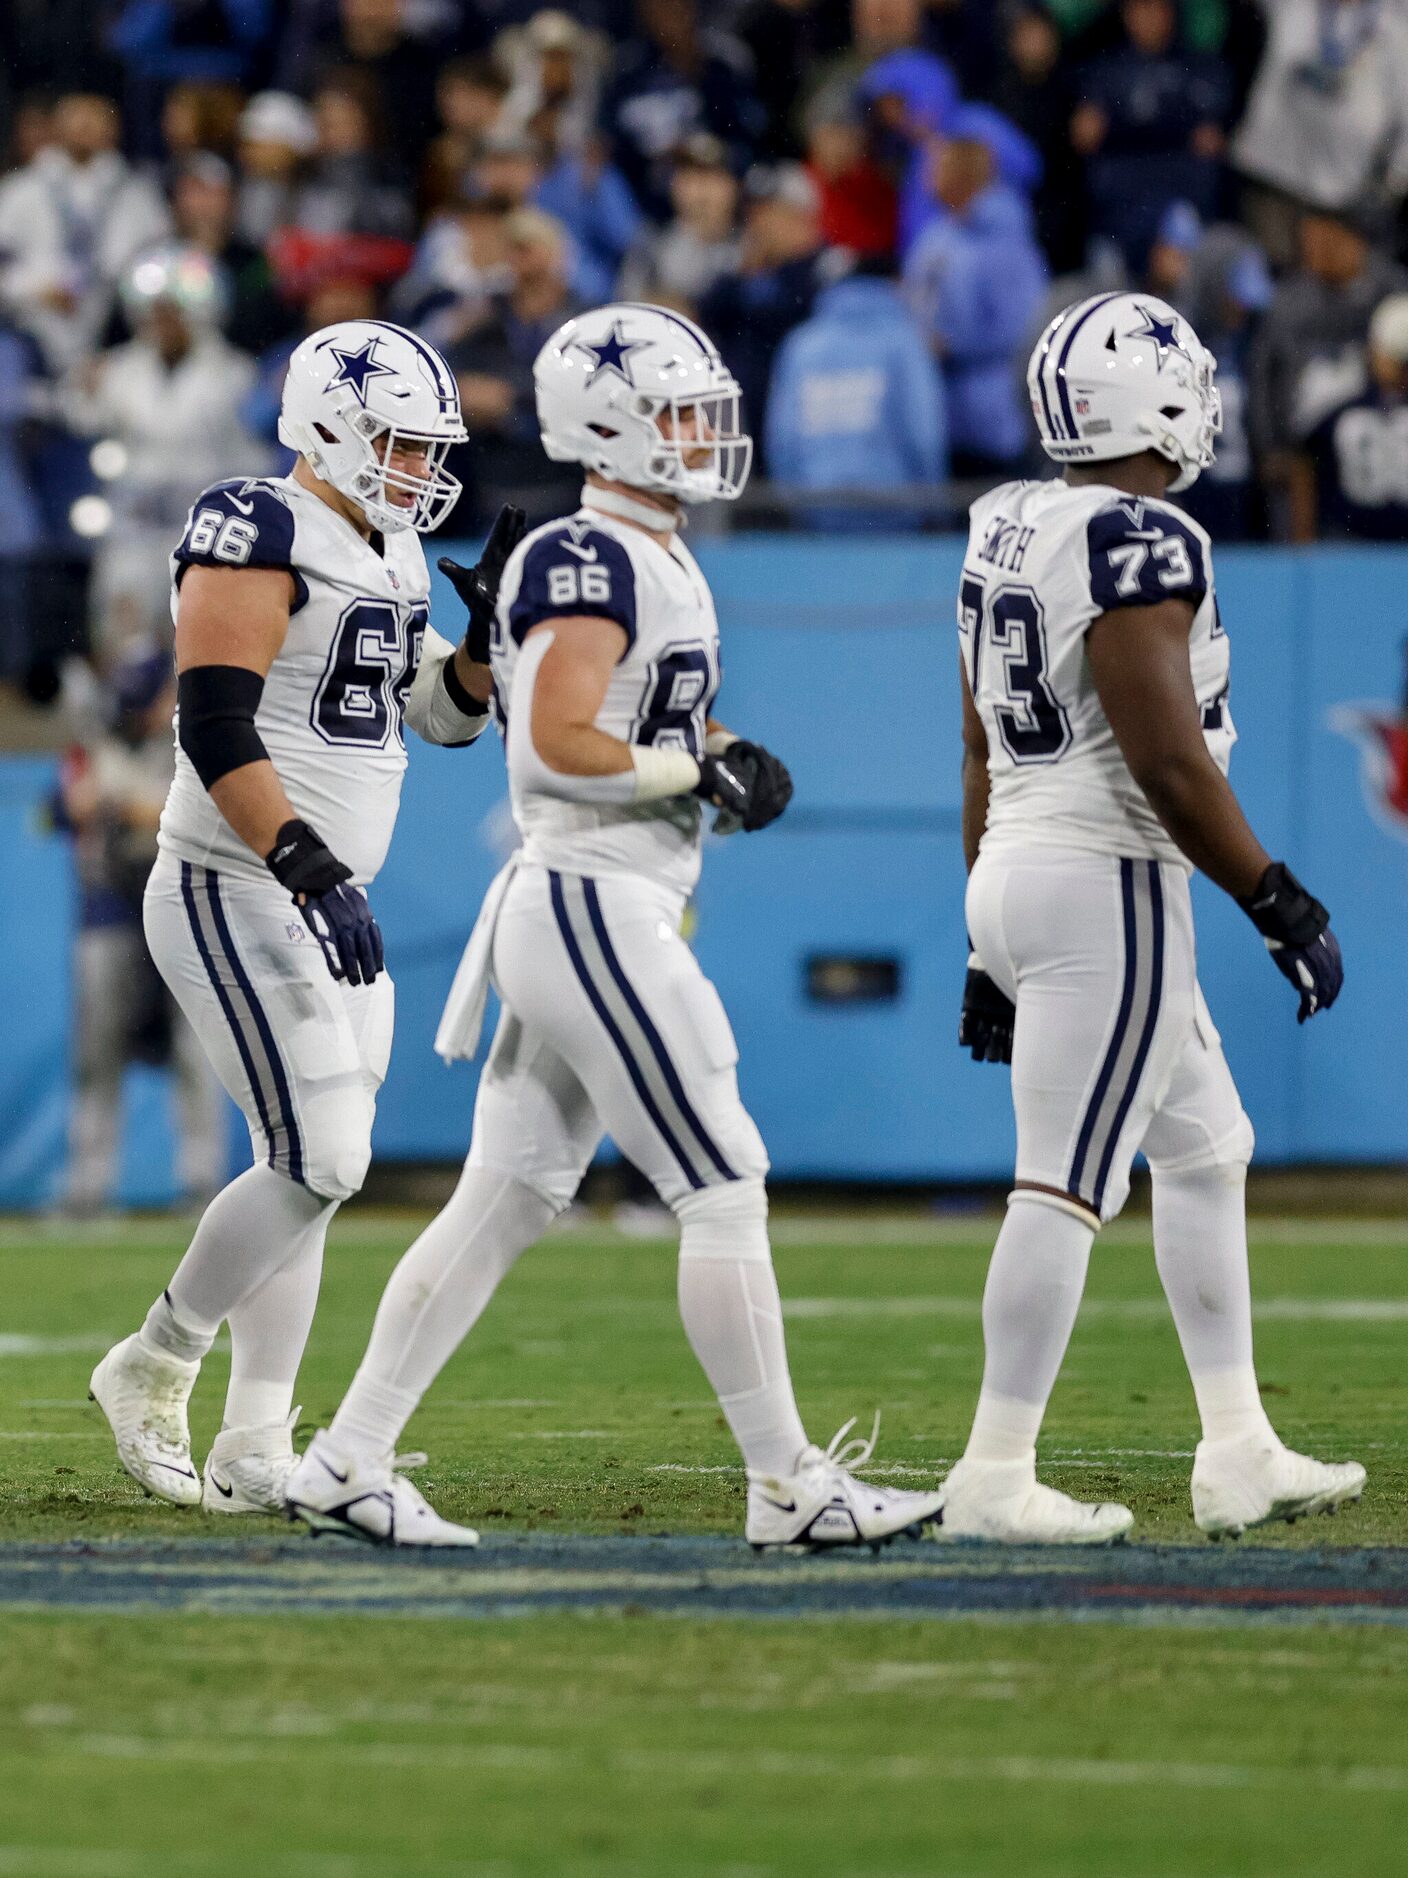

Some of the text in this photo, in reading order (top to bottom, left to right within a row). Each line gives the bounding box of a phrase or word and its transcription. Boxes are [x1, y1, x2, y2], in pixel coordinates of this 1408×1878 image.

[188, 508, 259, 564] 66
[1106, 534, 1193, 598] 73
[546, 563, 613, 606] 86
[957, 568, 1074, 766] 73
[628, 638, 721, 763] 8
